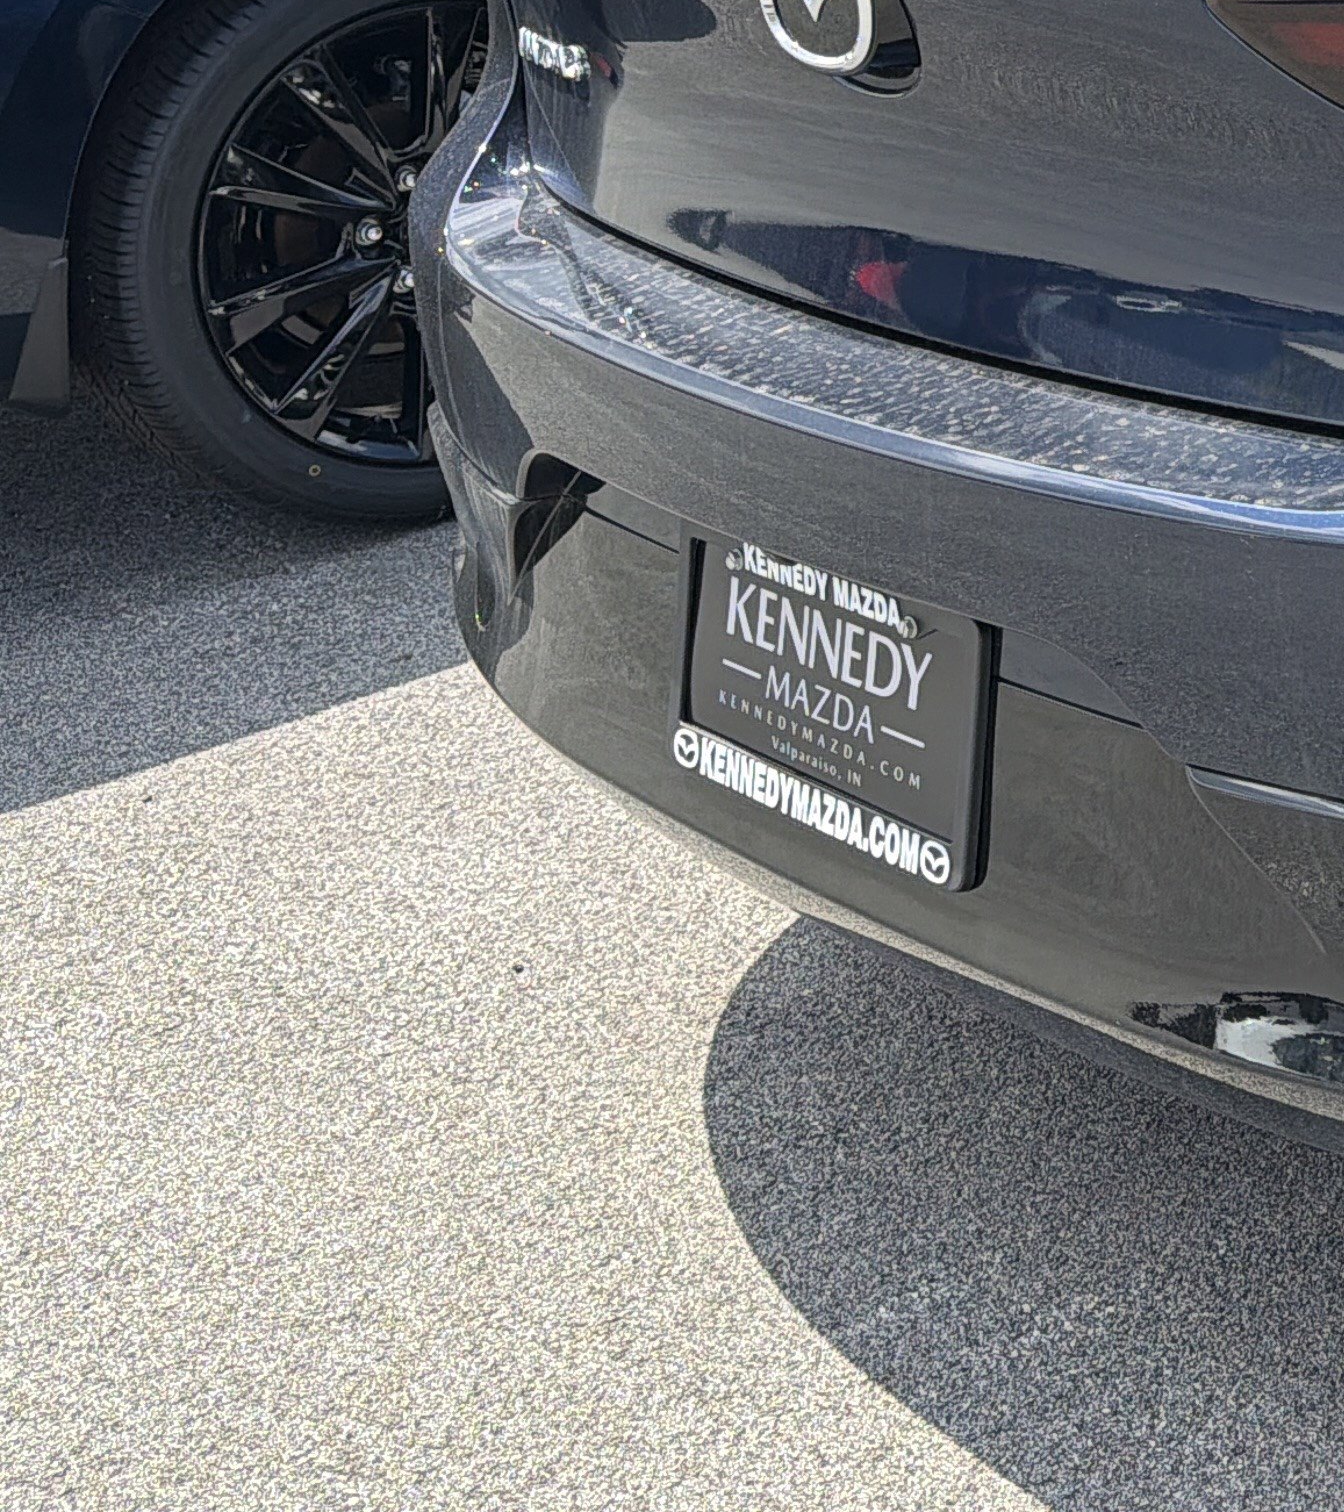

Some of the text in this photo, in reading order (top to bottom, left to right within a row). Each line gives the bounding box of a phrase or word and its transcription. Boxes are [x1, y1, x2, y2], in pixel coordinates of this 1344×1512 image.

[743, 542, 901, 628] KENNEDY MAZDA
[725, 576, 933, 711] KENNEDY
[718, 689, 921, 790] KENNEDYMAZDA.COM
[765, 665, 874, 744] MAZDA
[698, 736, 921, 875] KENNEDYMAZDA.COM
[847, 770, 862, 788] IN
